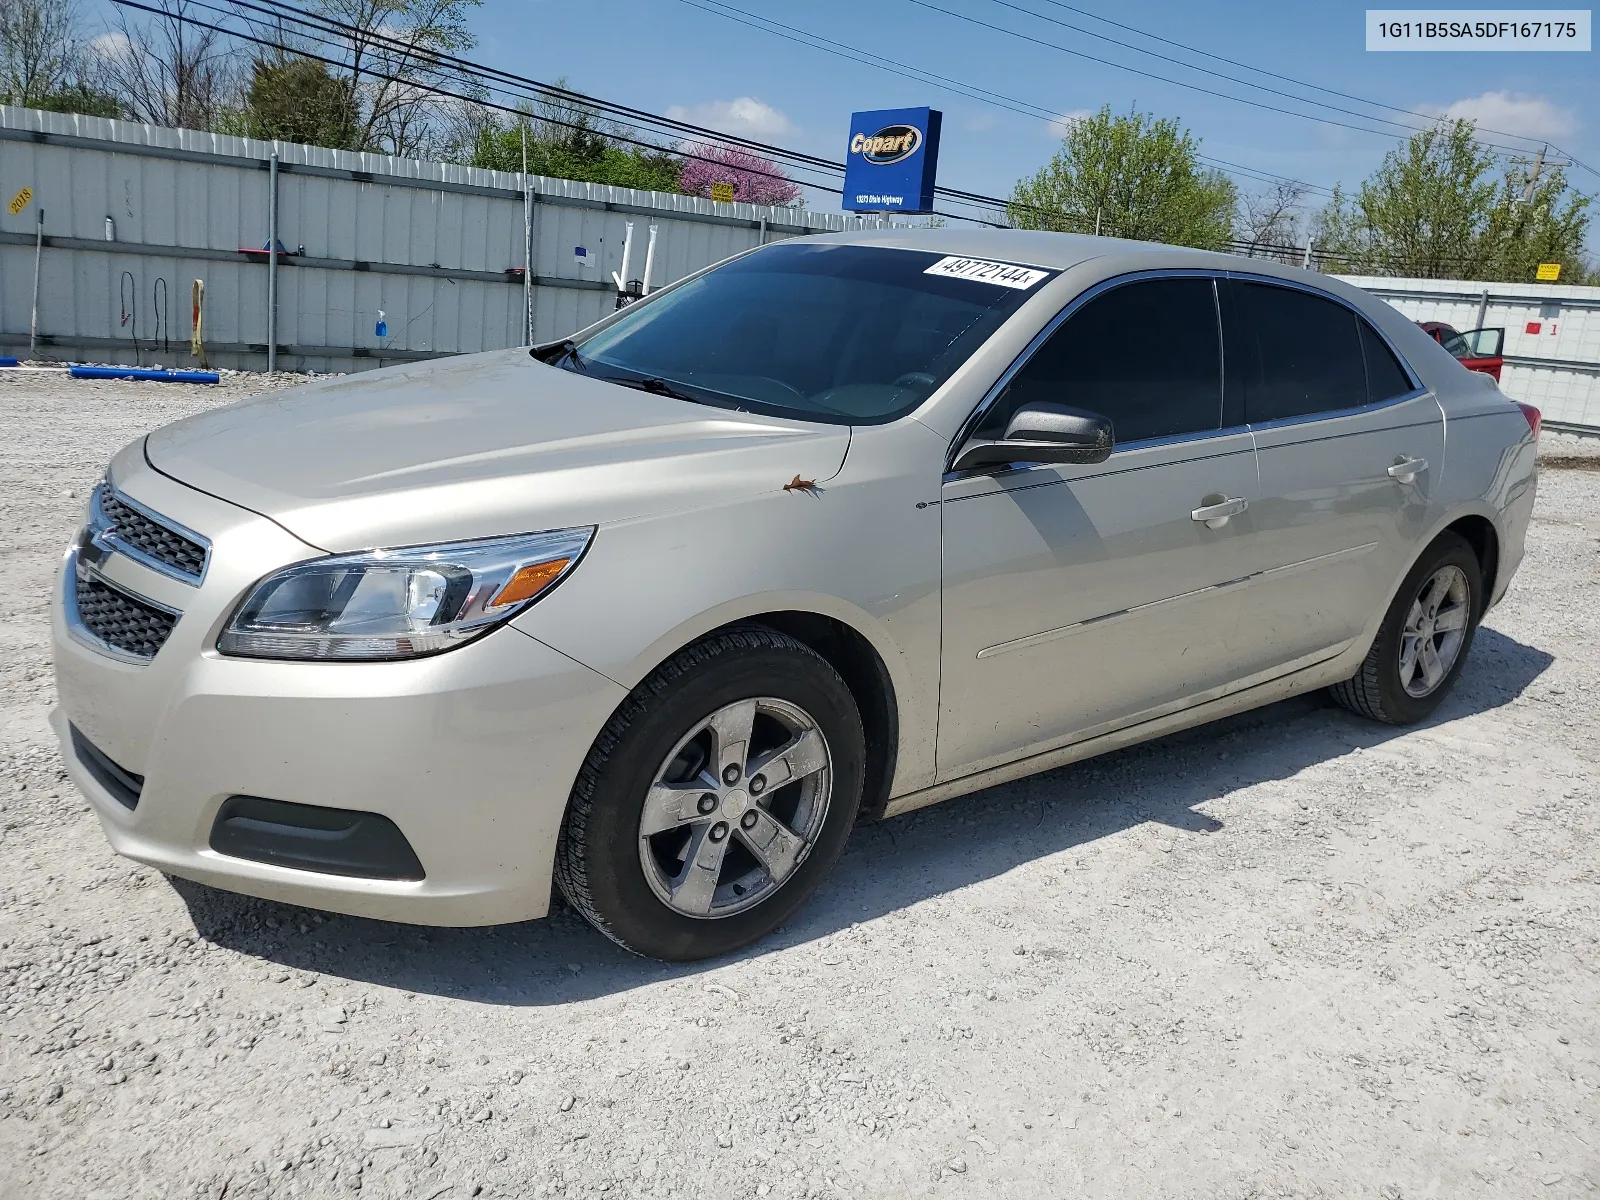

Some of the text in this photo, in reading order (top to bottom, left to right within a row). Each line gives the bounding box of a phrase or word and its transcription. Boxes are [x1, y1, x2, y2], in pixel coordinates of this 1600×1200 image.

[850, 130, 913, 158] Copart
[11, 188, 32, 214] 2018
[881, 195, 903, 206] Highway
[942, 258, 1031, 283] 49772144
